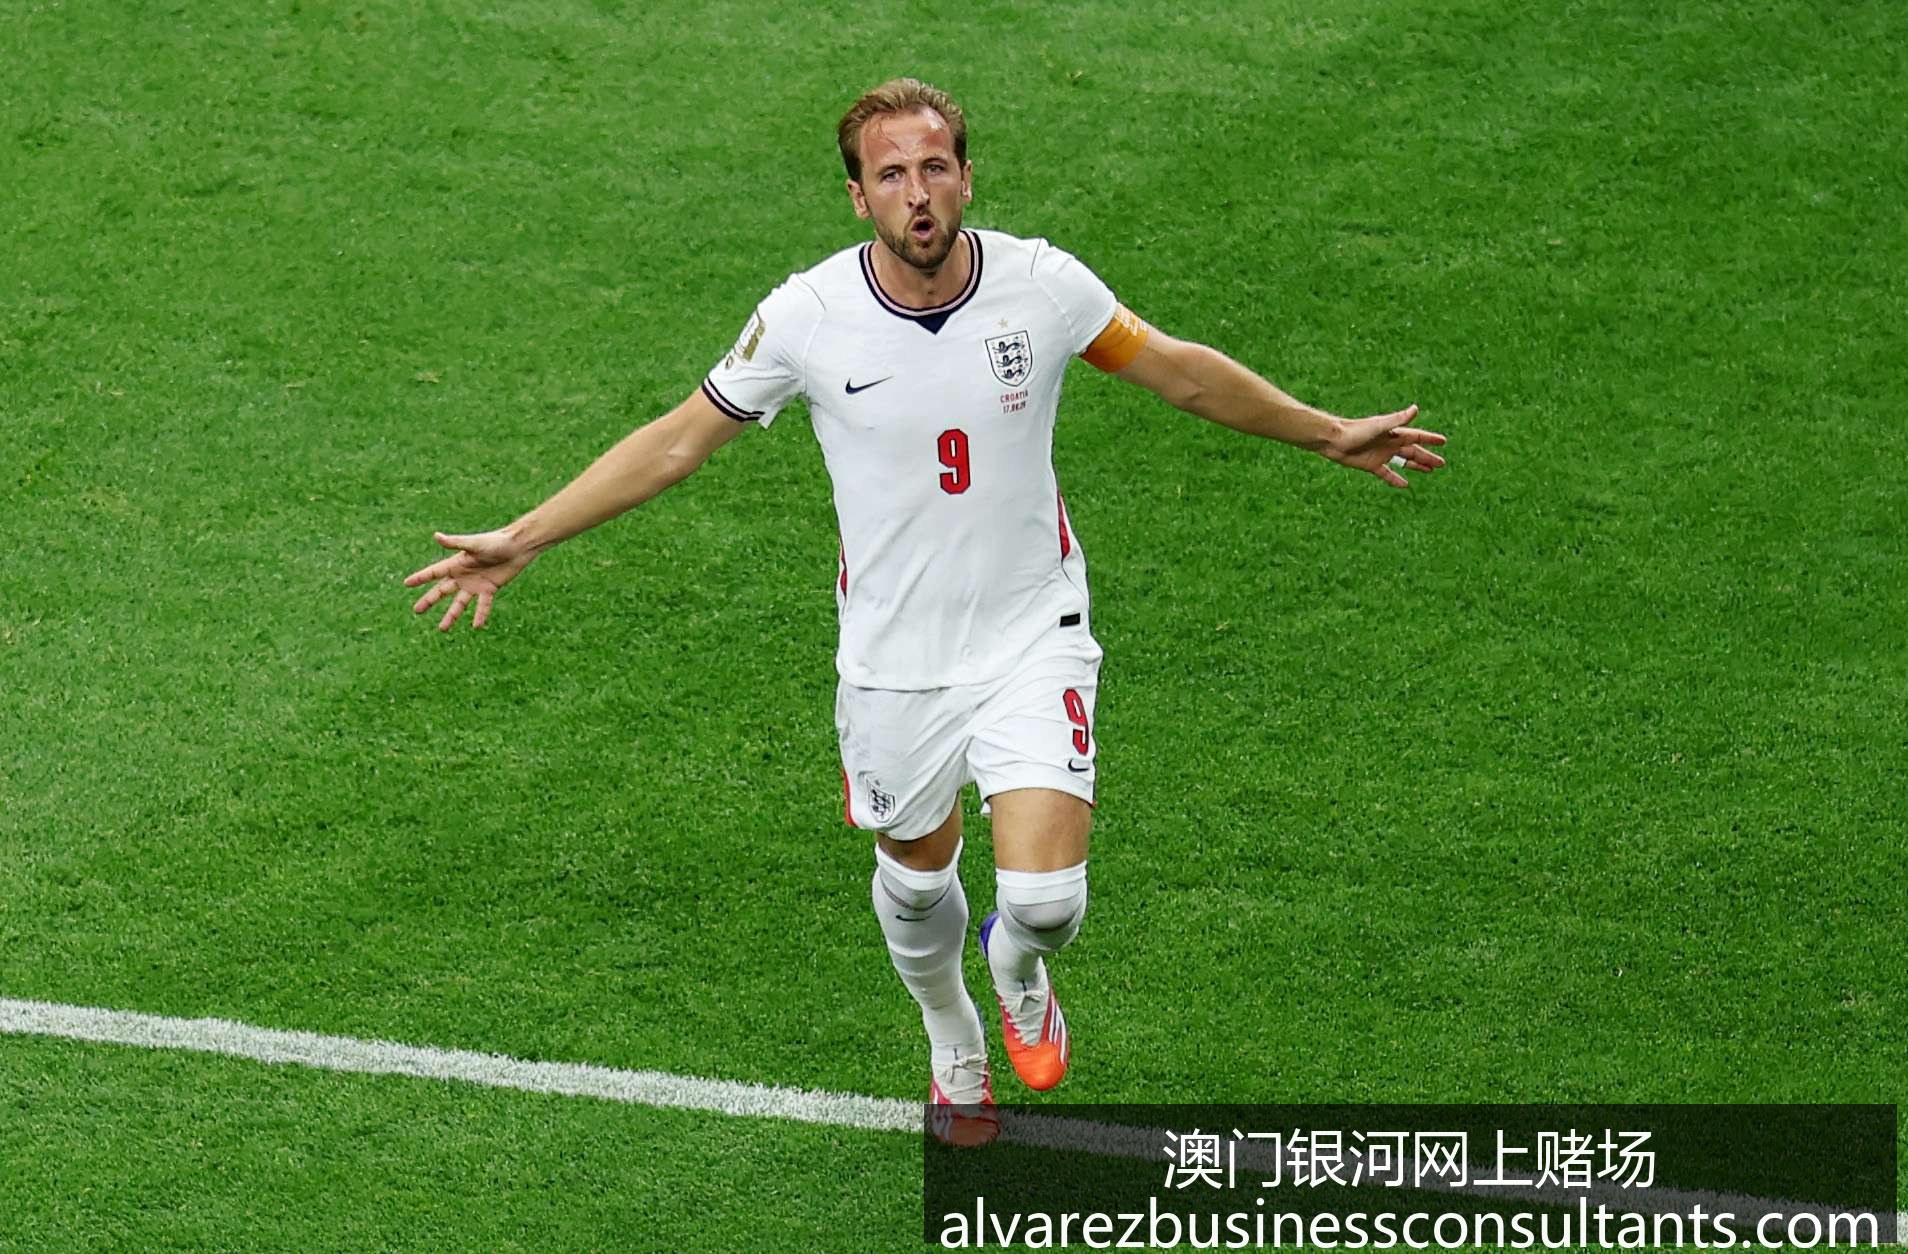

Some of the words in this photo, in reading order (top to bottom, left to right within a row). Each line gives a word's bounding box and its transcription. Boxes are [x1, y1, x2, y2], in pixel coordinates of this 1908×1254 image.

[1000, 390, 1028, 403] CROATIA
[937, 428, 971, 495] 9
[1063, 688, 1090, 756] 9
